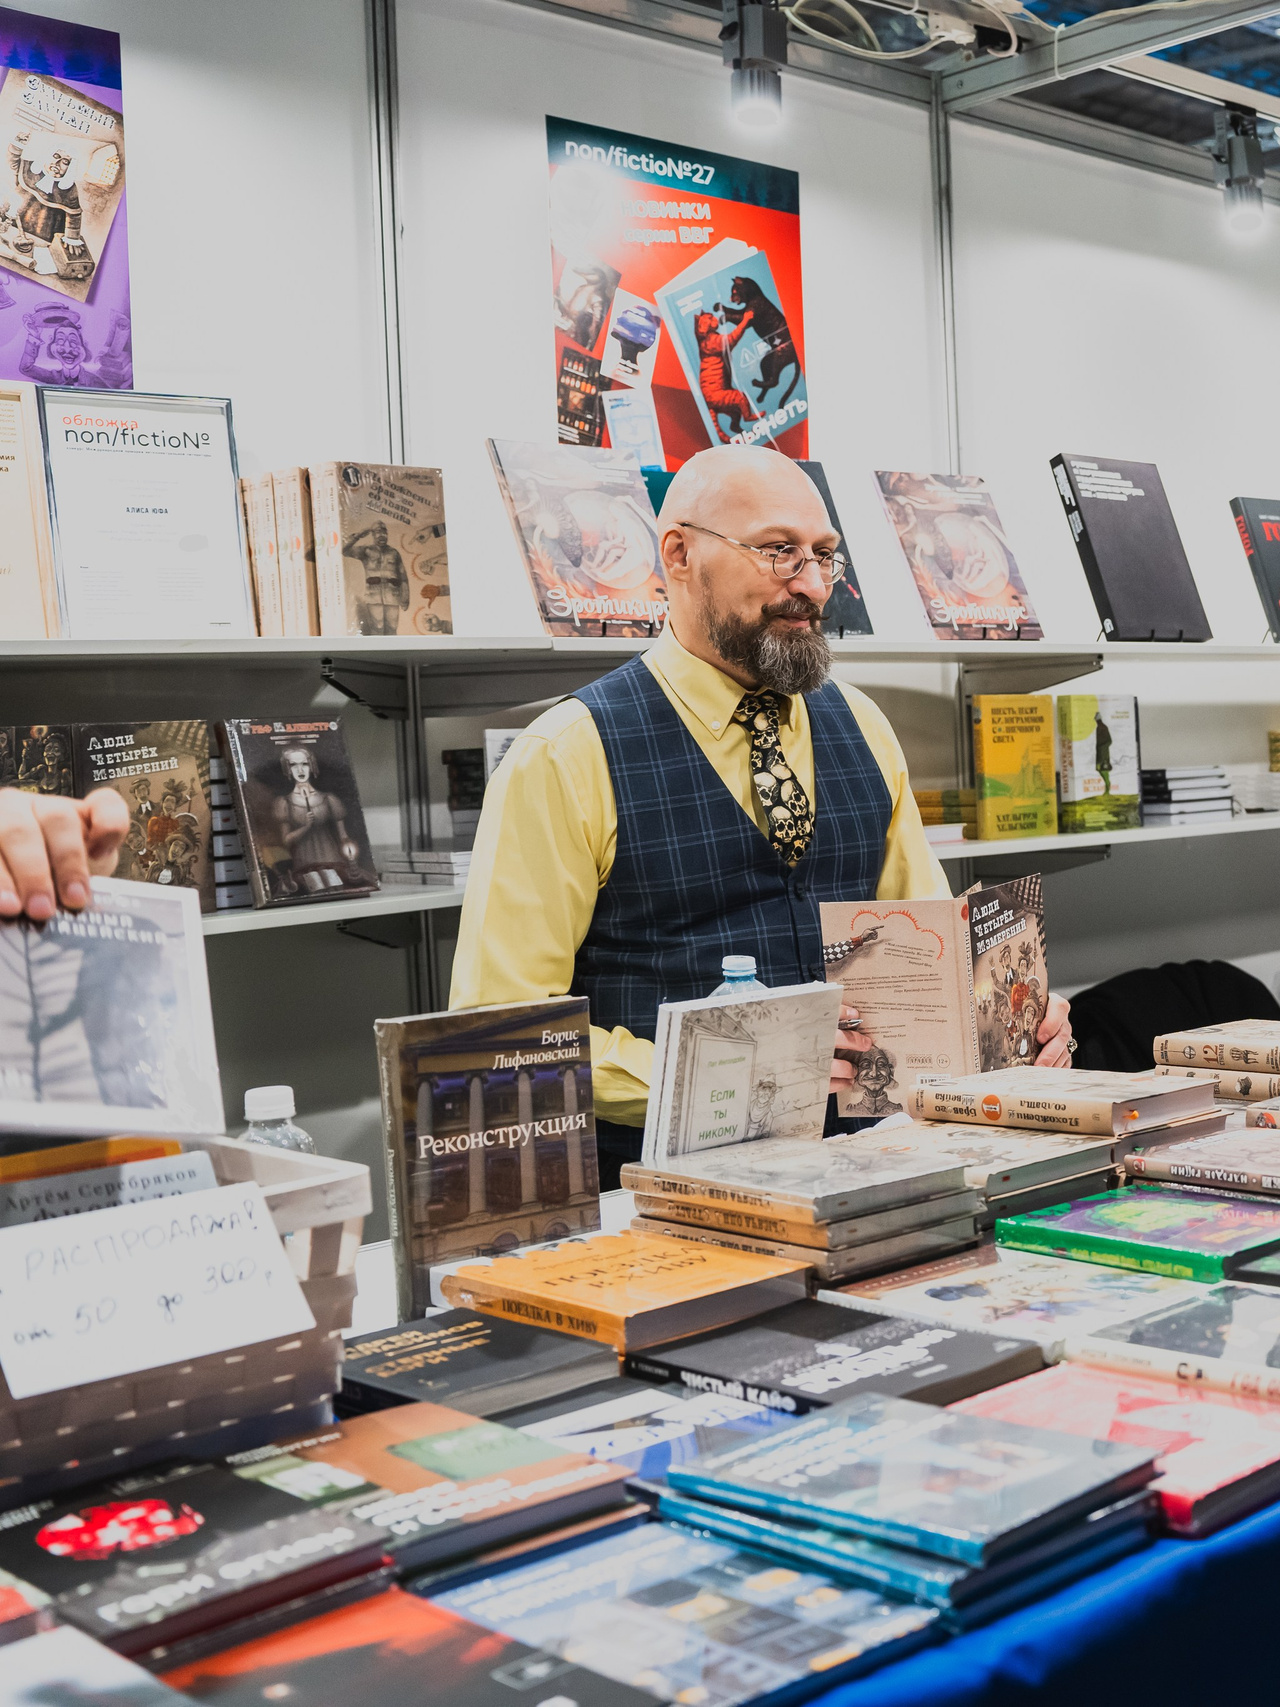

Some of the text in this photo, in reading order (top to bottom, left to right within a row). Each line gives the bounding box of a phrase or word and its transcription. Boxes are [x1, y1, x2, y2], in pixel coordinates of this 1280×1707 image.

[621, 199, 712, 221] НОВИНКИ
[62, 414, 139, 430] обложка
[541, 1029, 580, 1047] Борис
[493, 1043, 581, 1071] Лифановский
[1202, 1044, 1219, 1066] 12
[709, 1087, 735, 1104] Если
[713, 1107, 728, 1121] ты
[418, 1112, 588, 1160] Реконструкция
[698, 1122, 738, 1142] никому
[4, 1184, 73, 1212] Артём
[78, 1167, 198, 1198] Серебряков
[74, 1297, 118, 1335] 50
[501, 1298, 599, 1335] ПОЕЗДКА В ХИВУ
